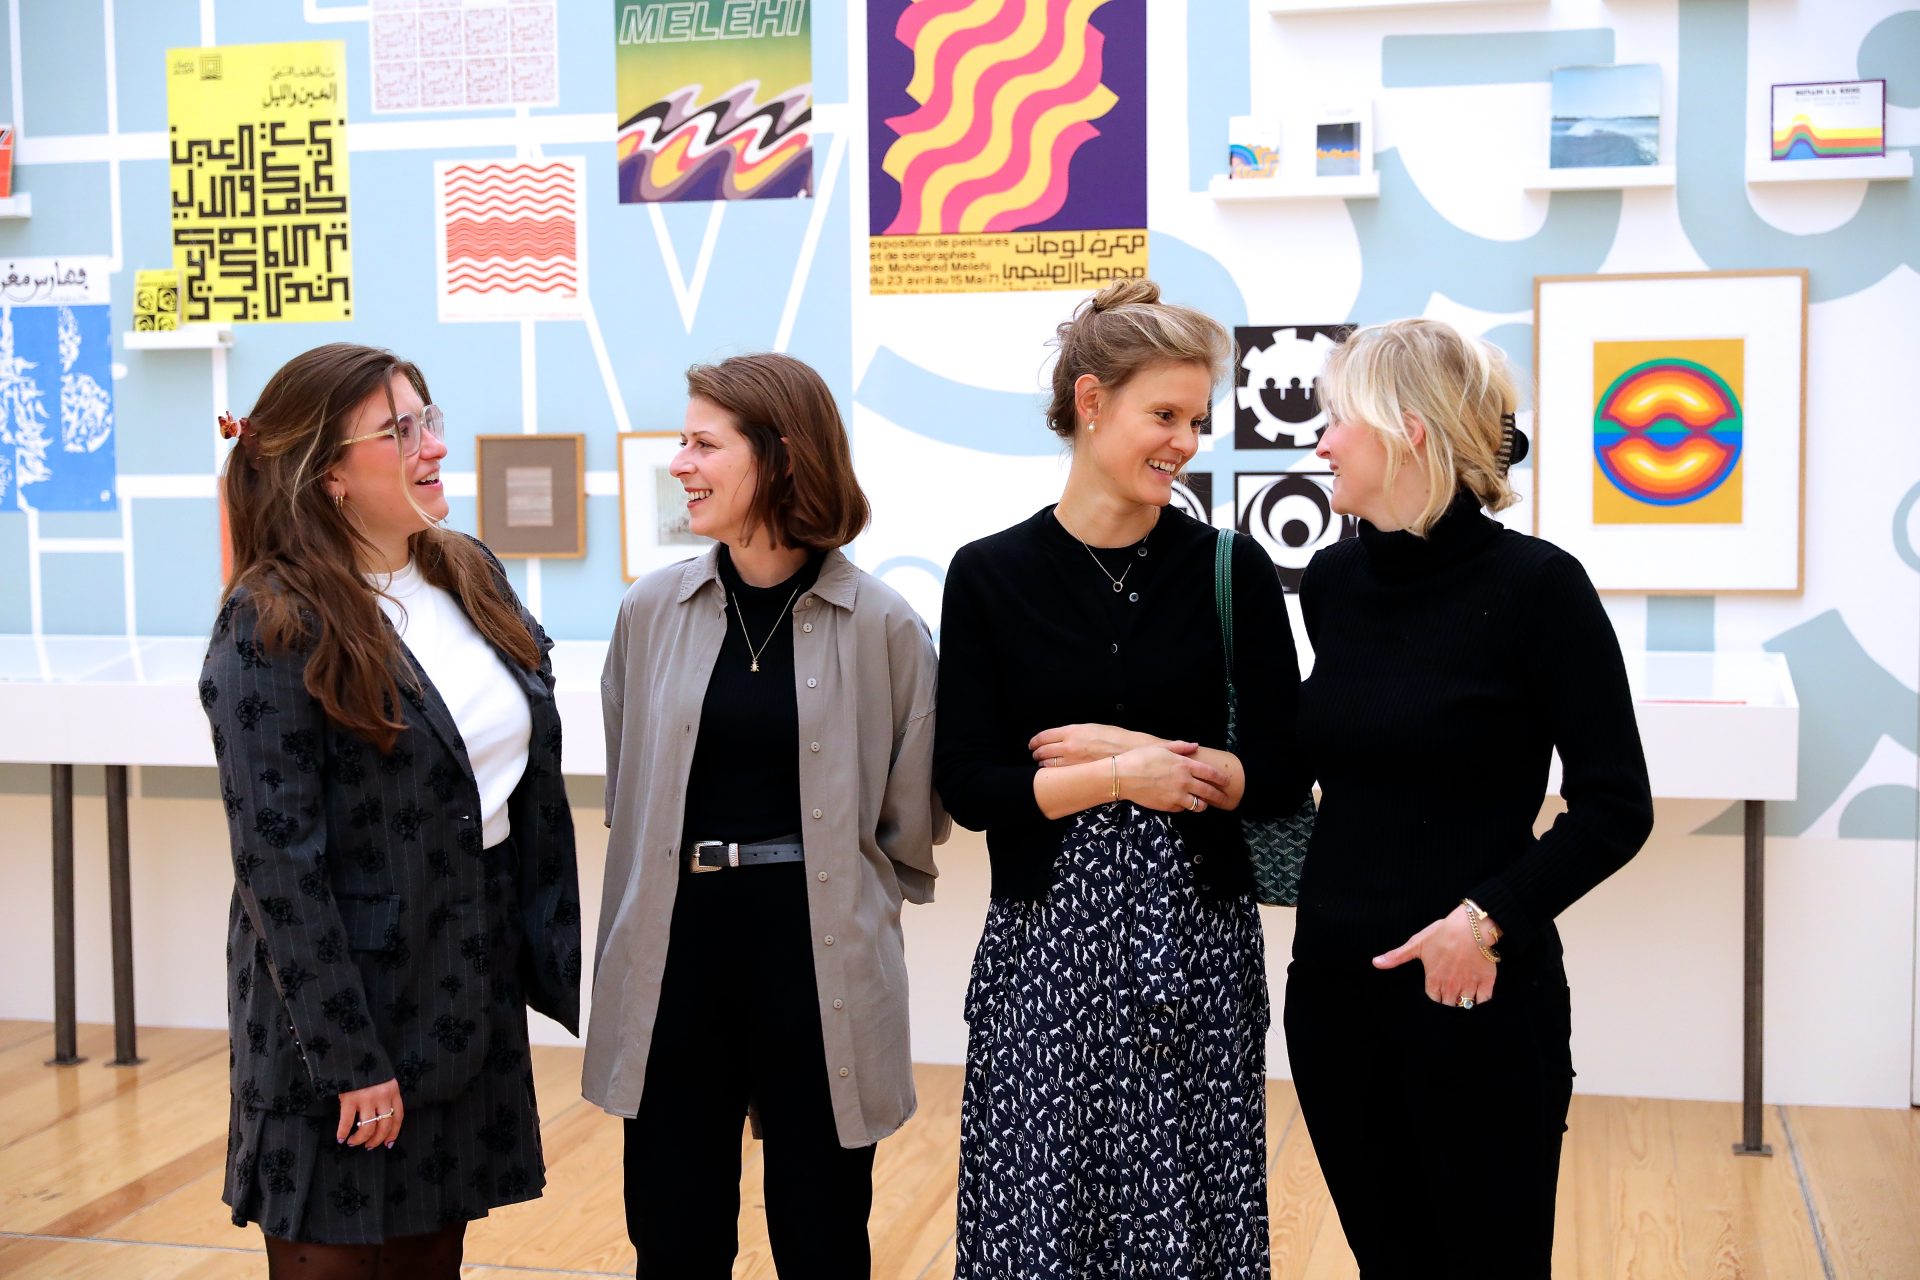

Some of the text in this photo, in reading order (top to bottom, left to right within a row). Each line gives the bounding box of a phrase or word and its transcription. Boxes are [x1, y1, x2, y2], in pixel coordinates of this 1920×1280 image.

[619, 0, 805, 45] MELEHI
[934, 238, 949, 248] de
[952, 237, 1010, 248] peintures
[870, 251, 882, 260] et
[884, 251, 899, 260] de
[869, 261, 991, 273] de Mohamed Melehi
[869, 275, 884, 286] du
[887, 275, 903, 285] 23
[907, 274, 932, 285] avril
[935, 275, 949, 285] au
